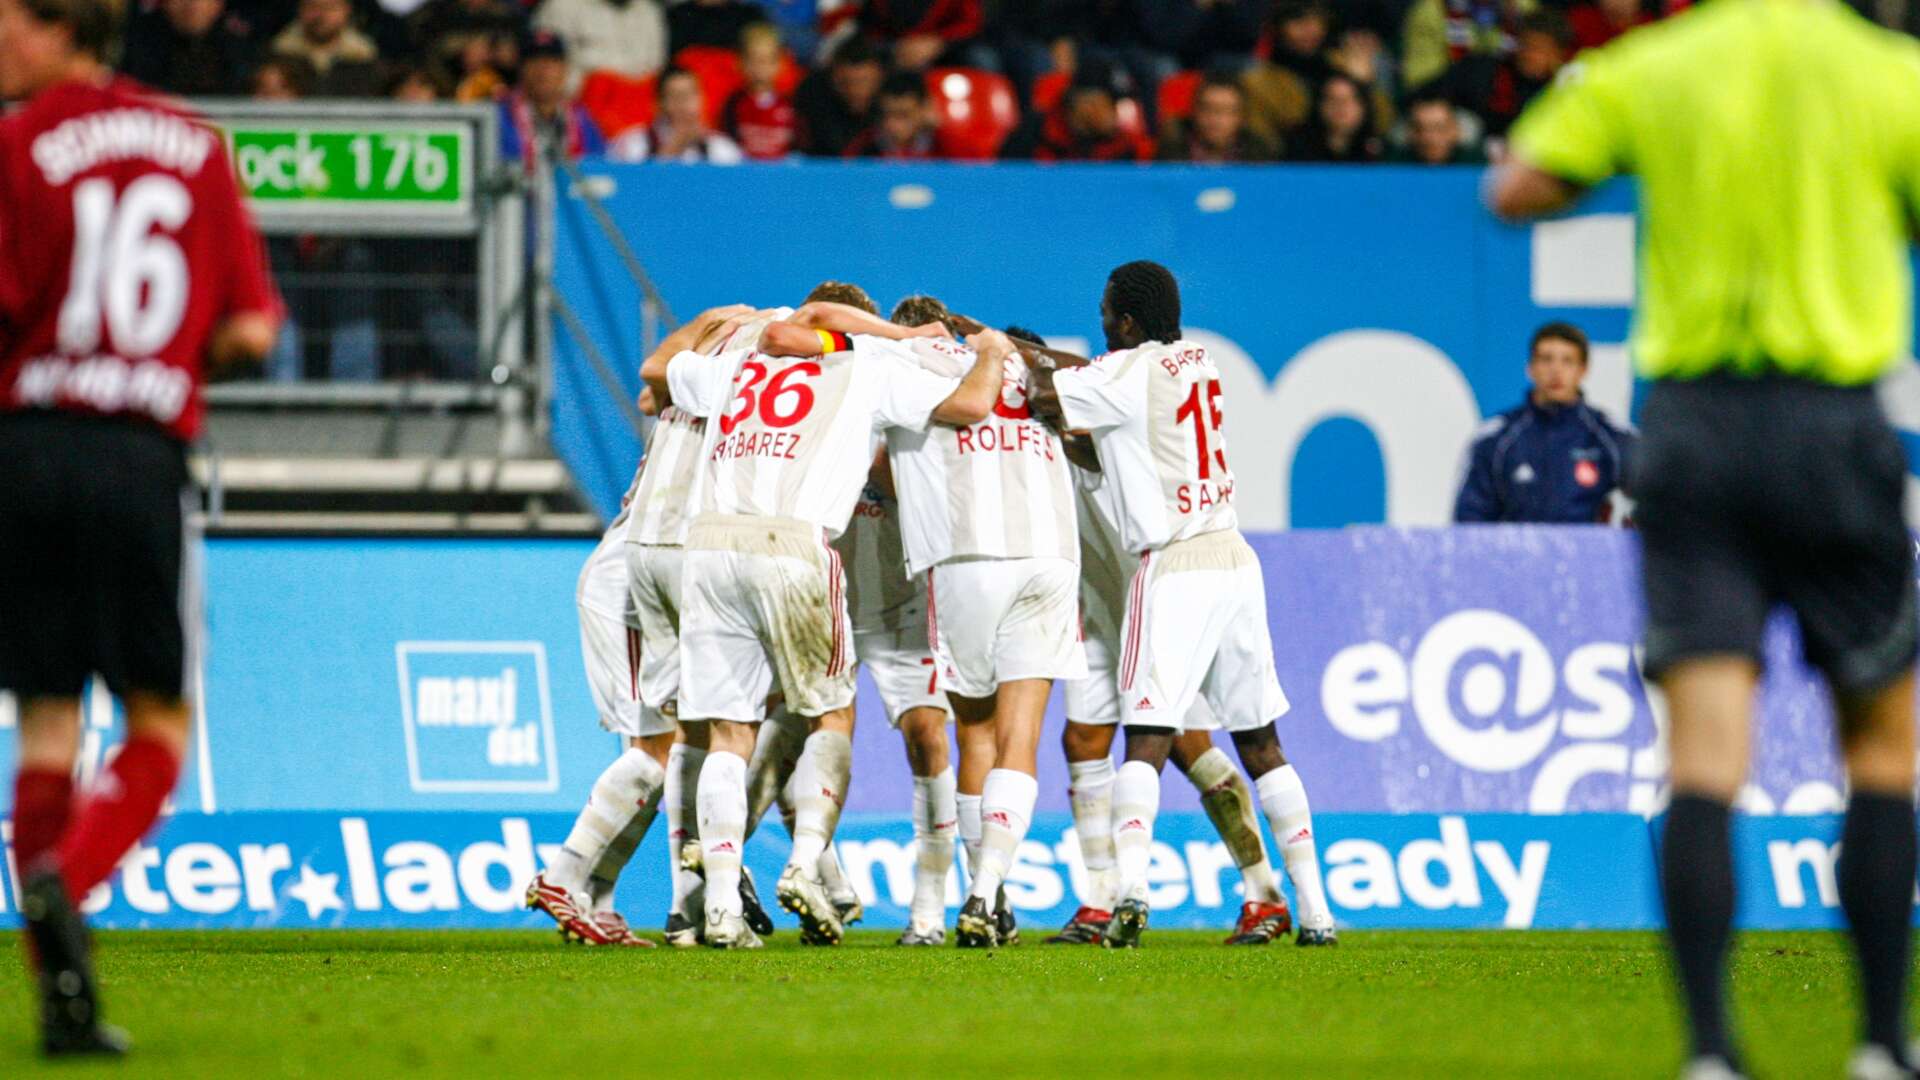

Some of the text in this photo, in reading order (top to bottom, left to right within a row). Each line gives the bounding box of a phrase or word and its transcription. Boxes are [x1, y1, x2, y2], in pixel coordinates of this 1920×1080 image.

[56, 172, 194, 357] 16
[712, 431, 801, 462] ARBAREZ
[719, 361, 822, 435] 36
[1175, 379, 1228, 480] 15
[1325, 815, 1551, 928] ady
